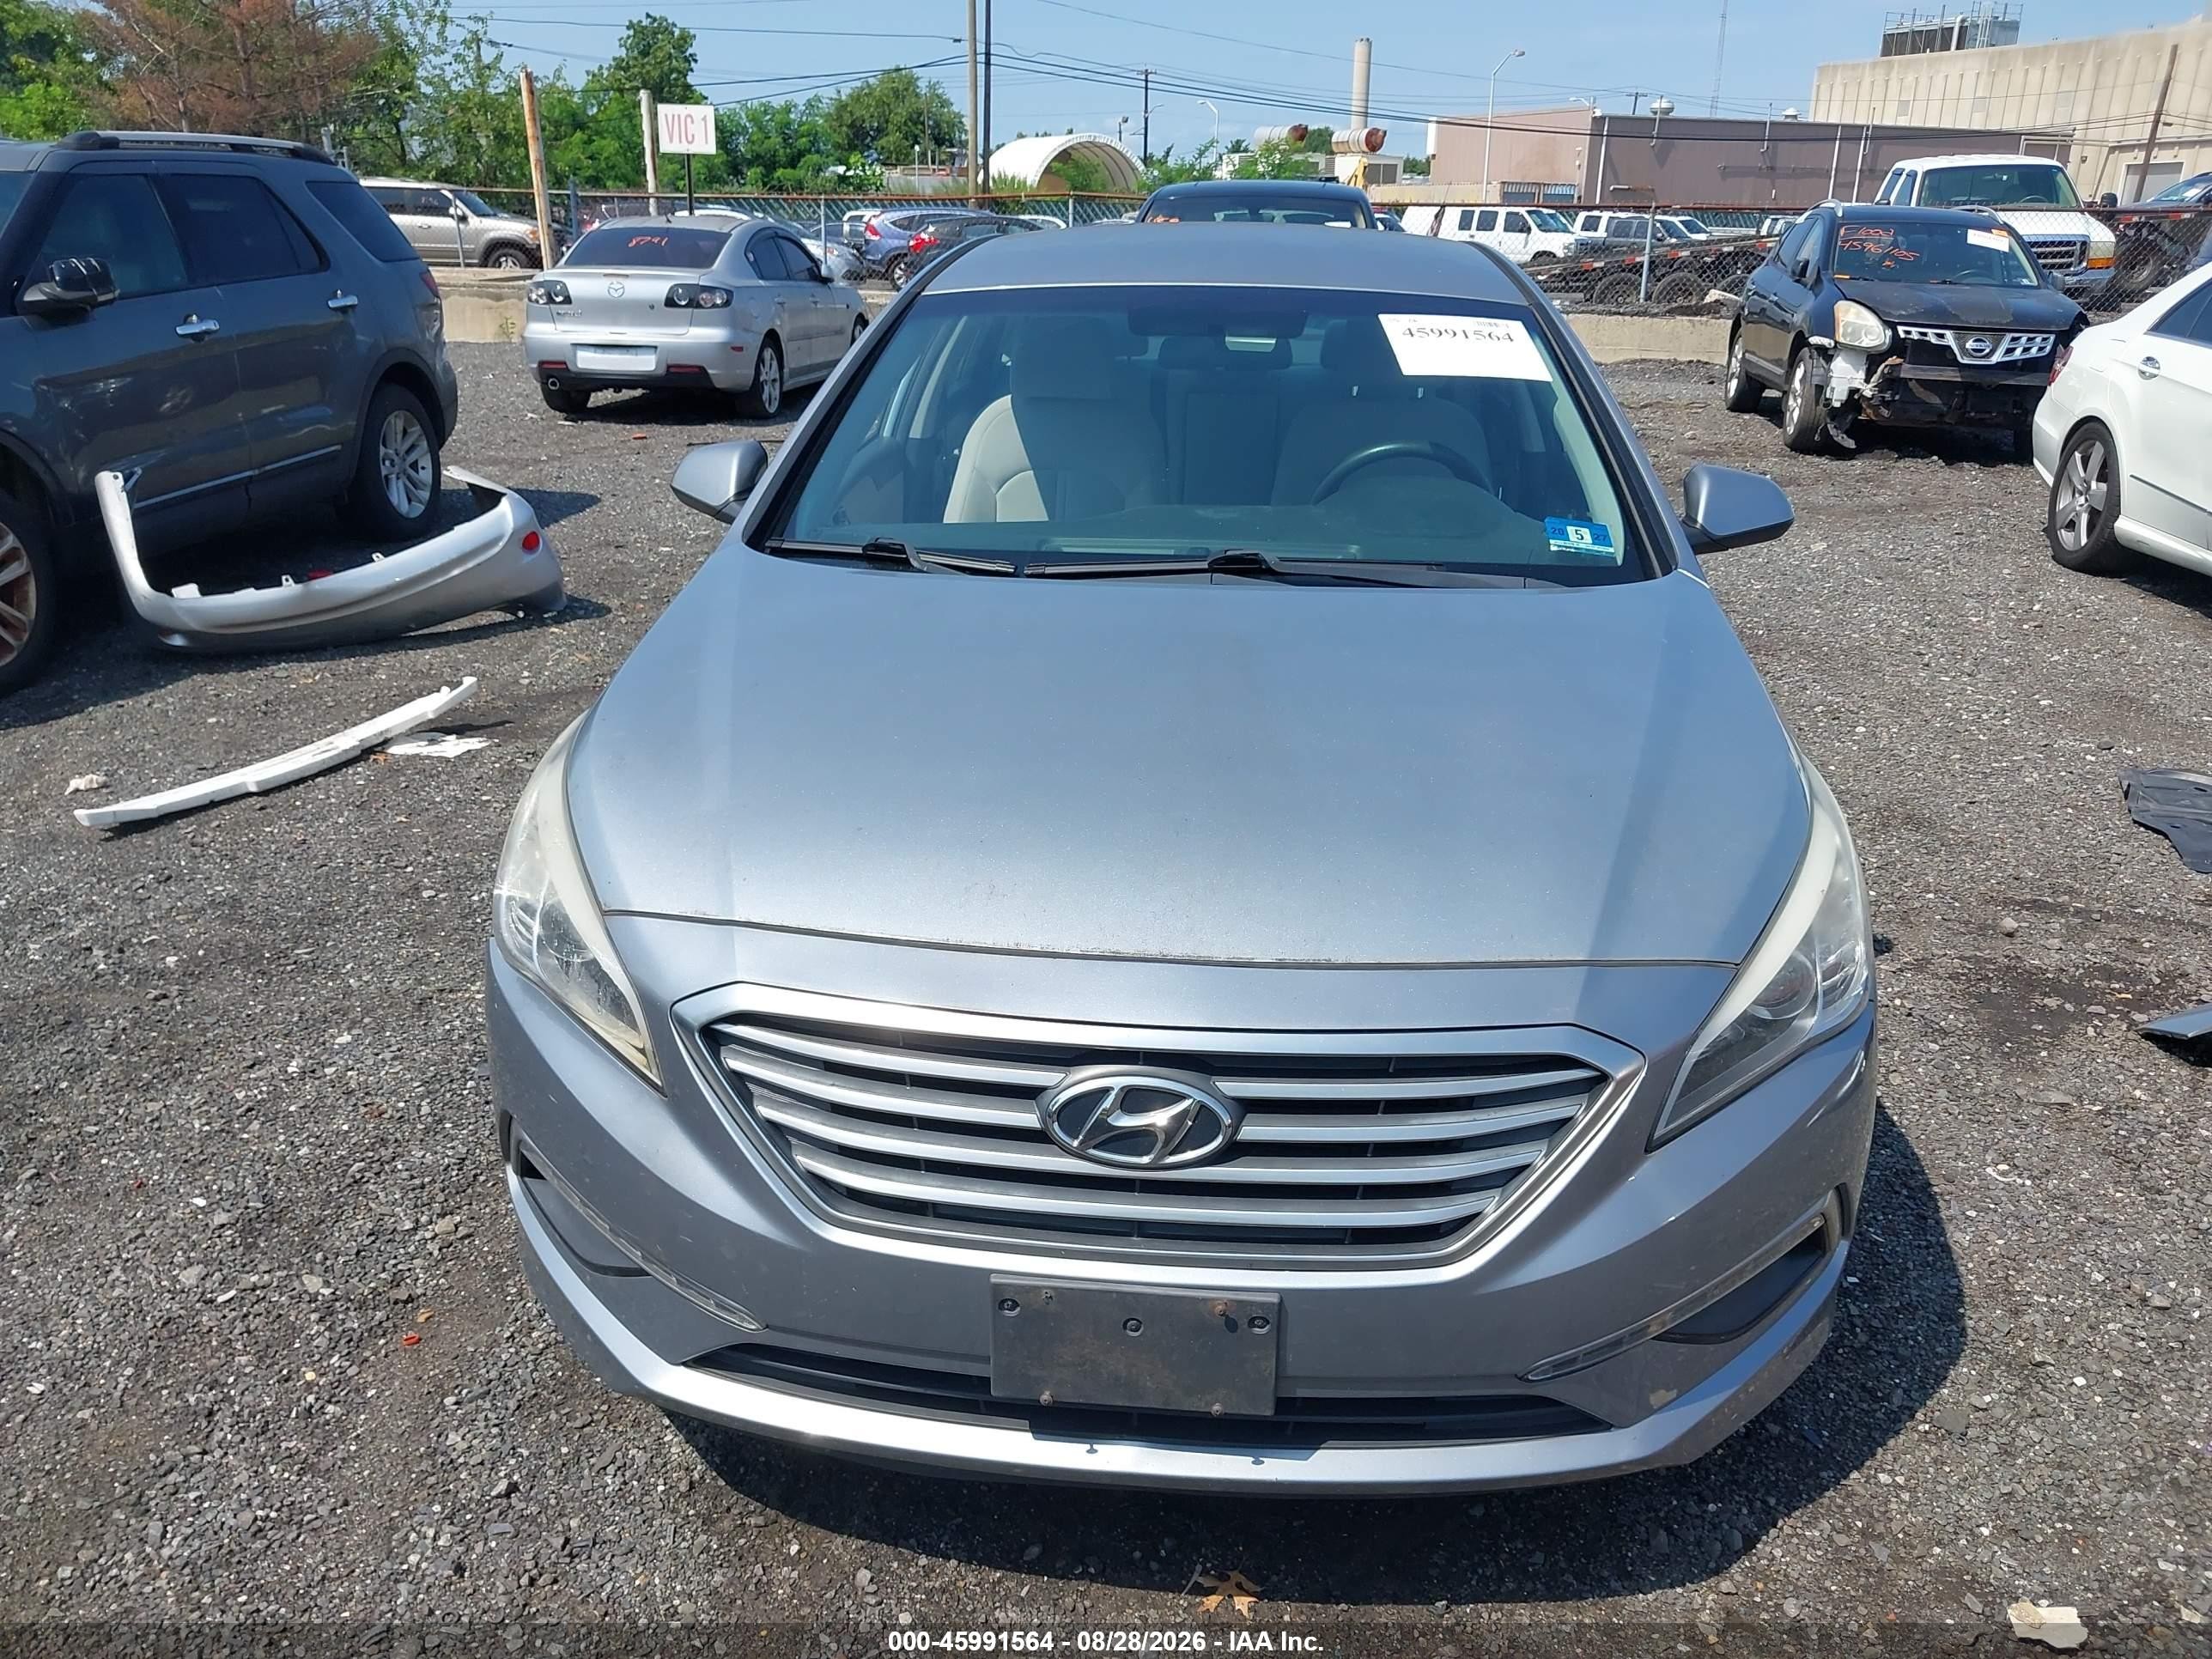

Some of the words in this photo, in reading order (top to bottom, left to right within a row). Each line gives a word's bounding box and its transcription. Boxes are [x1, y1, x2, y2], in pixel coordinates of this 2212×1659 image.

[665, 113, 695, 145] VIC
[701, 114, 708, 145] 1
[1402, 328, 1514, 342] 45991564
[1574, 529, 1585, 541] 5
[1593, 533, 1608, 542] 27
